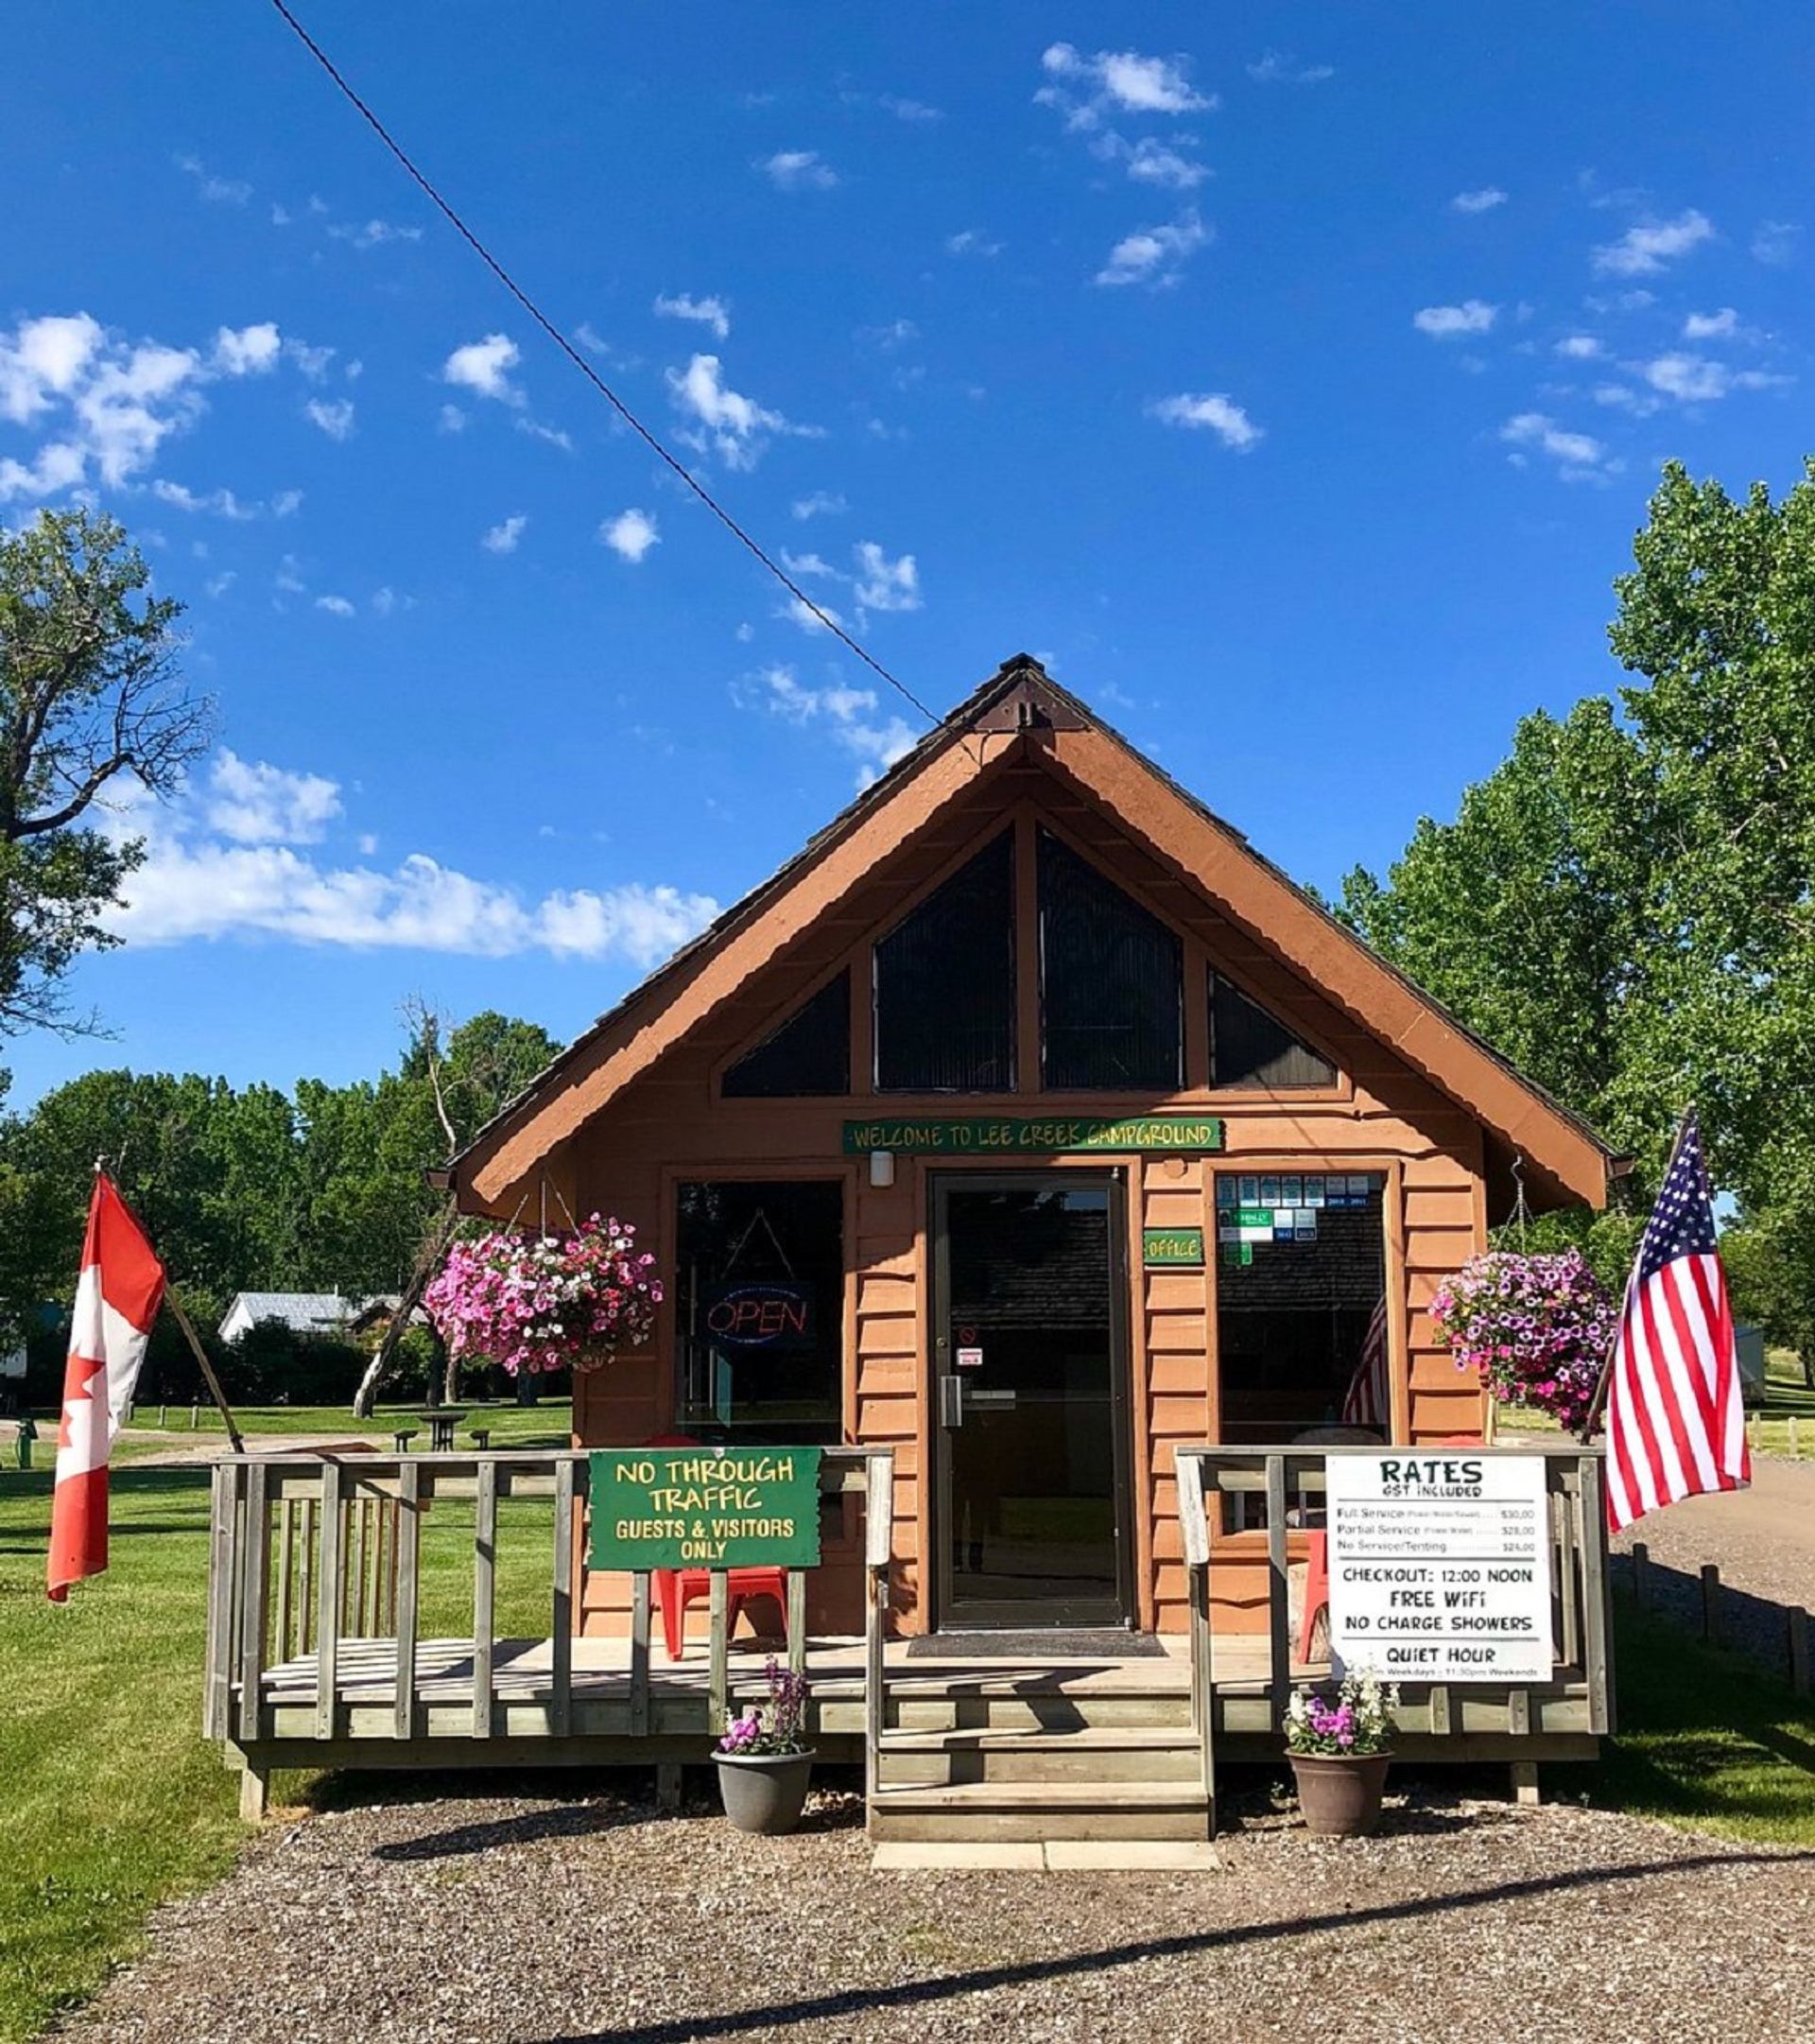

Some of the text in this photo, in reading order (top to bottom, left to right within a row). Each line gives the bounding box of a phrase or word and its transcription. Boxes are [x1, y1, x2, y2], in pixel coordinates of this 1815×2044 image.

[854, 1122, 1212, 1147] WELCOME TO LEE CREEK CAMPGROUND
[1150, 1239, 1198, 1257] OFFICE
[708, 1300, 807, 1333] OPEN
[616, 1456, 794, 1484] NO THROUGH
[1379, 1460, 1482, 1483] RATES
[648, 1485, 763, 1513] TRAFFIC
[1382, 1484, 1410, 1498] GST
[1337, 1508, 1358, 1518] Full
[1361, 1508, 1405, 1519] Service
[615, 1518, 794, 1539] GUESTS & VISITORS
[1337, 1524, 1375, 1535] Partial
[1378, 1525, 1420, 1535] Service
[681, 1541, 727, 1559] ONLY
[1337, 1540, 1354, 1550] No
[1342, 1568, 1533, 1583] CHECKOUT: 12:00 NOON
[1391, 1590, 1435, 1607] FREE
[1345, 1616, 1533, 1631] NO CHARGE SHOWERS
[1448, 1647, 1495, 1663] HOUR
[1388, 1668, 1435, 1678] Weekdays
[1489, 1667, 1538, 1676] Weekends
